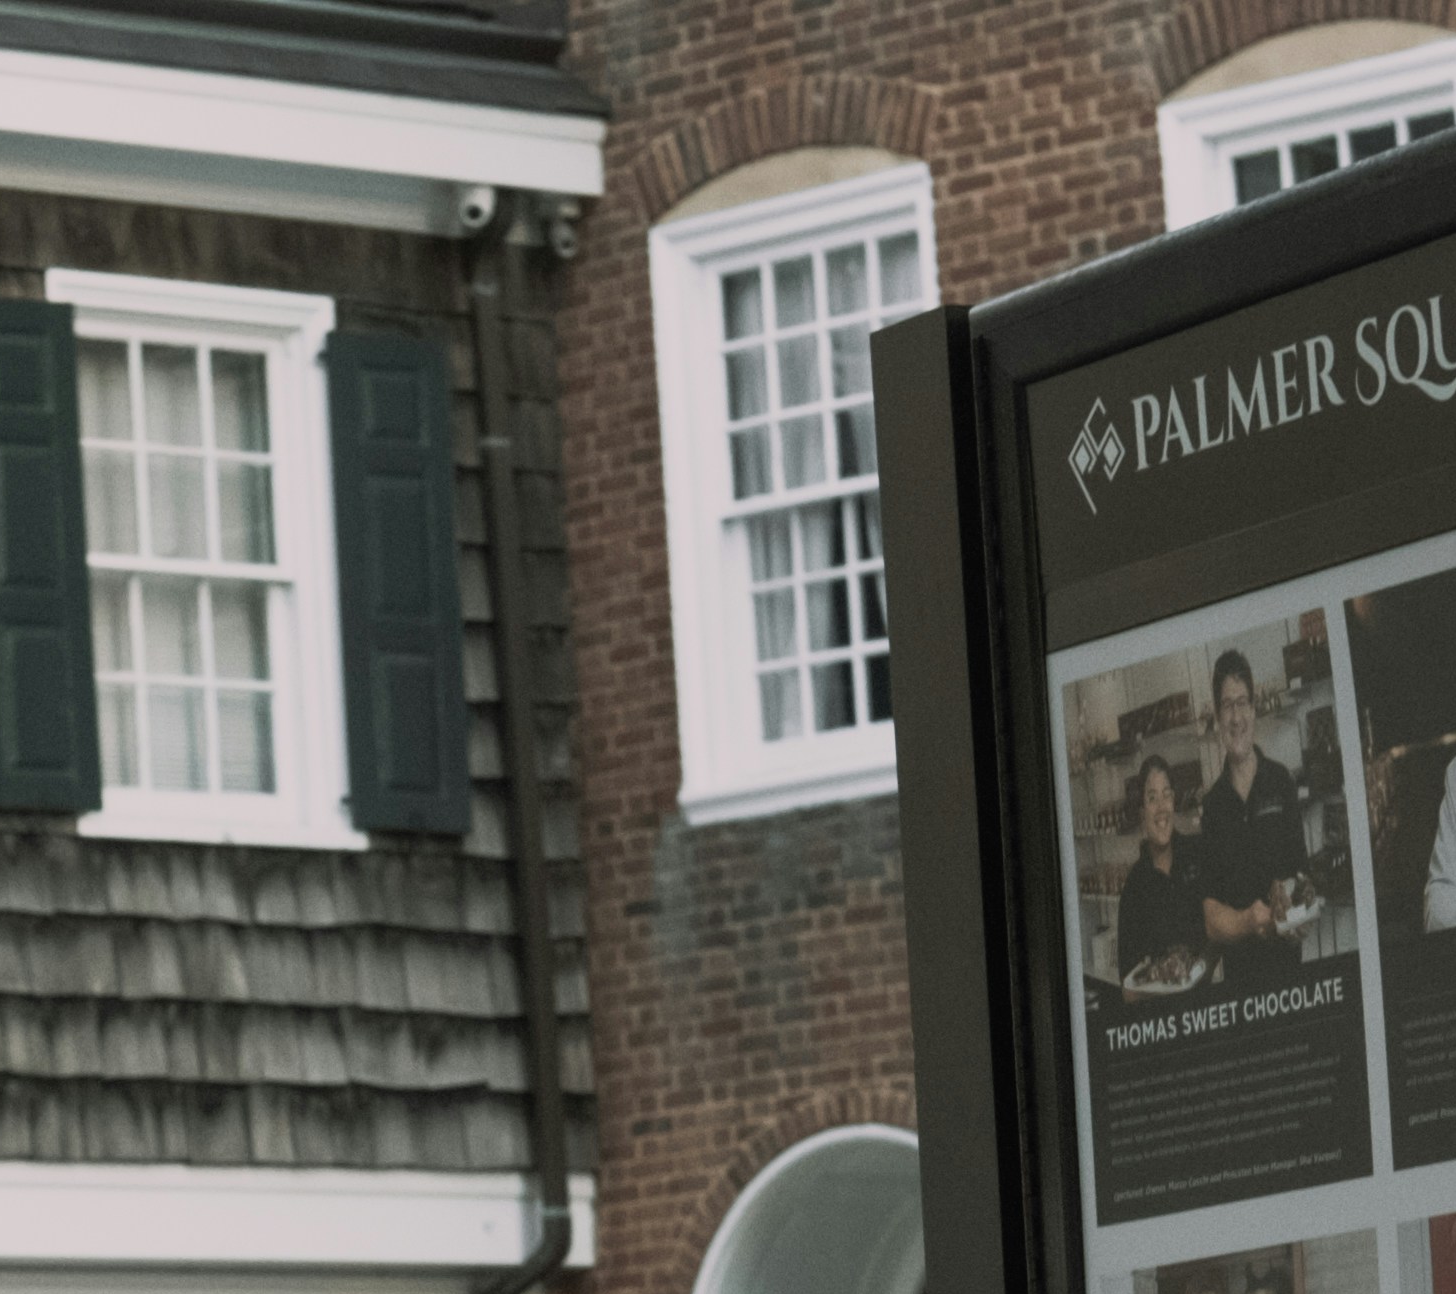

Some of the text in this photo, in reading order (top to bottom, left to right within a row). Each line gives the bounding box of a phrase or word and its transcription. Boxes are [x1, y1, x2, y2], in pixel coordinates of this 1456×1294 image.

[1131, 334, 1346, 471] PALMER
[1106, 977, 1343, 1051] THOMAS SWEET CHOCOLATE
